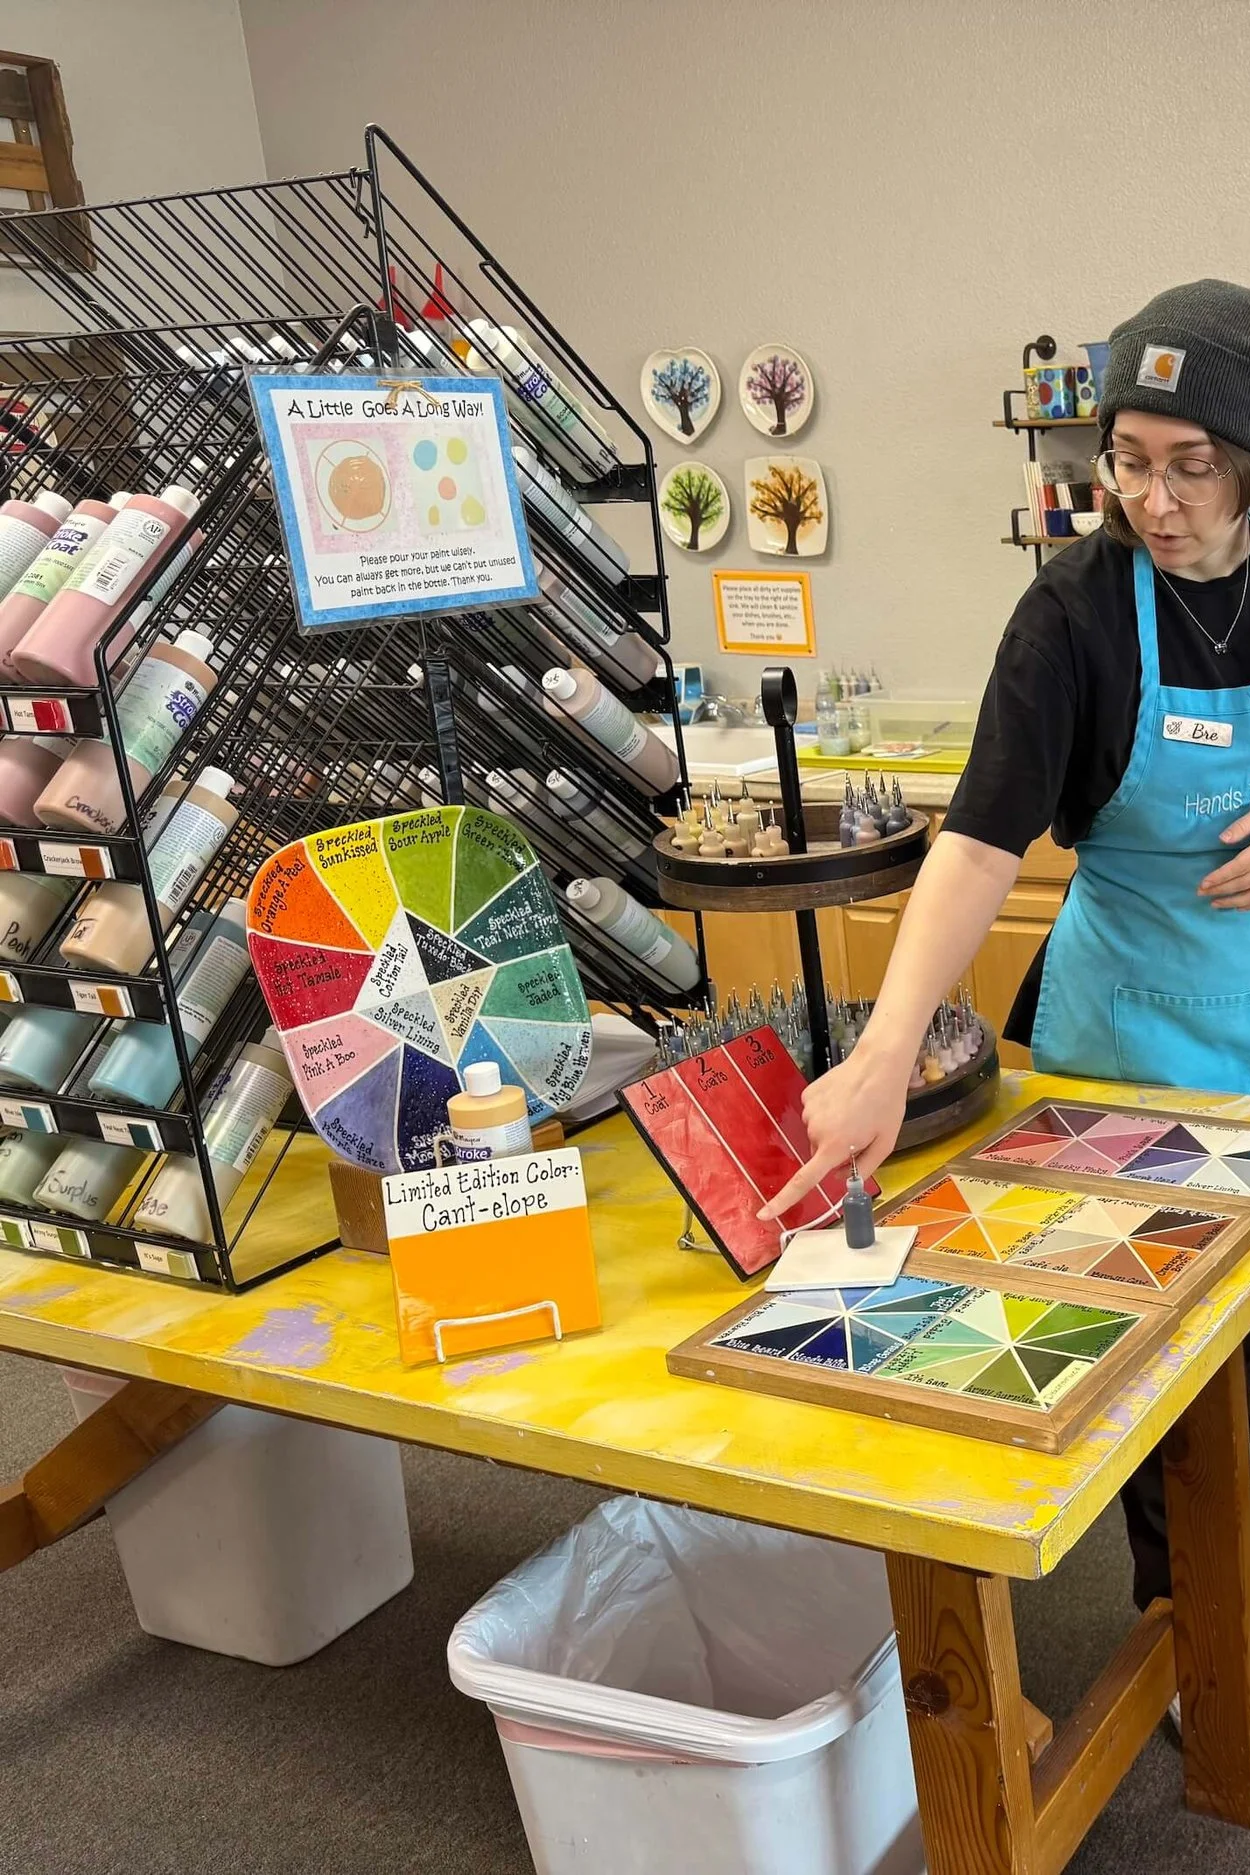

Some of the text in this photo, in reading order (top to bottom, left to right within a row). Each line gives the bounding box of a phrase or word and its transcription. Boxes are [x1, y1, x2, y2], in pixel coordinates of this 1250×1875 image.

[288, 398, 484, 418] A Little Goes A Long Way!
[360, 546, 476, 567] Please pour your paint wisely.
[315, 556, 516, 588] You can always get more, but we can't put unused
[351, 574, 494, 598] paint back in the bottle. Thank you.
[1192, 723, 1218, 741] Bre
[1185, 787, 1242, 818] Hands
[392, 811, 443, 834] Speckled
[462, 823, 495, 852] Green
[474, 815, 526, 853] Speckled
[316, 826, 372, 853] Speckled
[318, 837, 378, 869] Sunkissed
[388, 825, 451, 851] Sour Apple
[254, 860, 284, 918] Speckled
[260, 859, 306, 934] Orange A Peel
[488, 900, 533, 930] Speckled
[426, 928, 467, 961] Speckled
[474, 911, 559, 950] Teal Next Time
[274, 952, 328, 975] Speckled
[370, 944, 396, 987] Speckled
[416, 934, 473, 974] Tuxedo Black
[300, 967, 342, 989] Tamale
[379, 943, 409, 998] Cotton Tail
[517, 966, 561, 995] Speckled
[444, 983, 471, 1025] Speckled
[526, 983, 562, 1006] Jaded
[392, 1002, 436, 1033] Speckled
[450, 986, 484, 1039] Vanilla Dip
[374, 1006, 440, 1055] Silver Lining
[744, 1035, 762, 1054] 3
[302, 1034, 344, 1060] Speckled
[746, 1050, 775, 1070] Coats
[302, 1051, 356, 1081] Pink A Boo
[545, 1042, 572, 1088] Speckled
[696, 1056, 712, 1076] 2
[549, 1084, 572, 1106] My
[563, 1068, 584, 1099] Blue
[641, 1081, 658, 1100] 1
[698, 1070, 728, 1092] Coats
[644, 1094, 670, 1116] Coat
[322, 1121, 386, 1170] Purple Haze
[330, 1117, 374, 1156] Speckled
[48, 1170, 98, 1208] Surplus
[386, 1158, 580, 1205] Limited Edition Color:
[422, 1192, 548, 1232] Cant-elope
[726, 1338, 750, 1350] Blue
